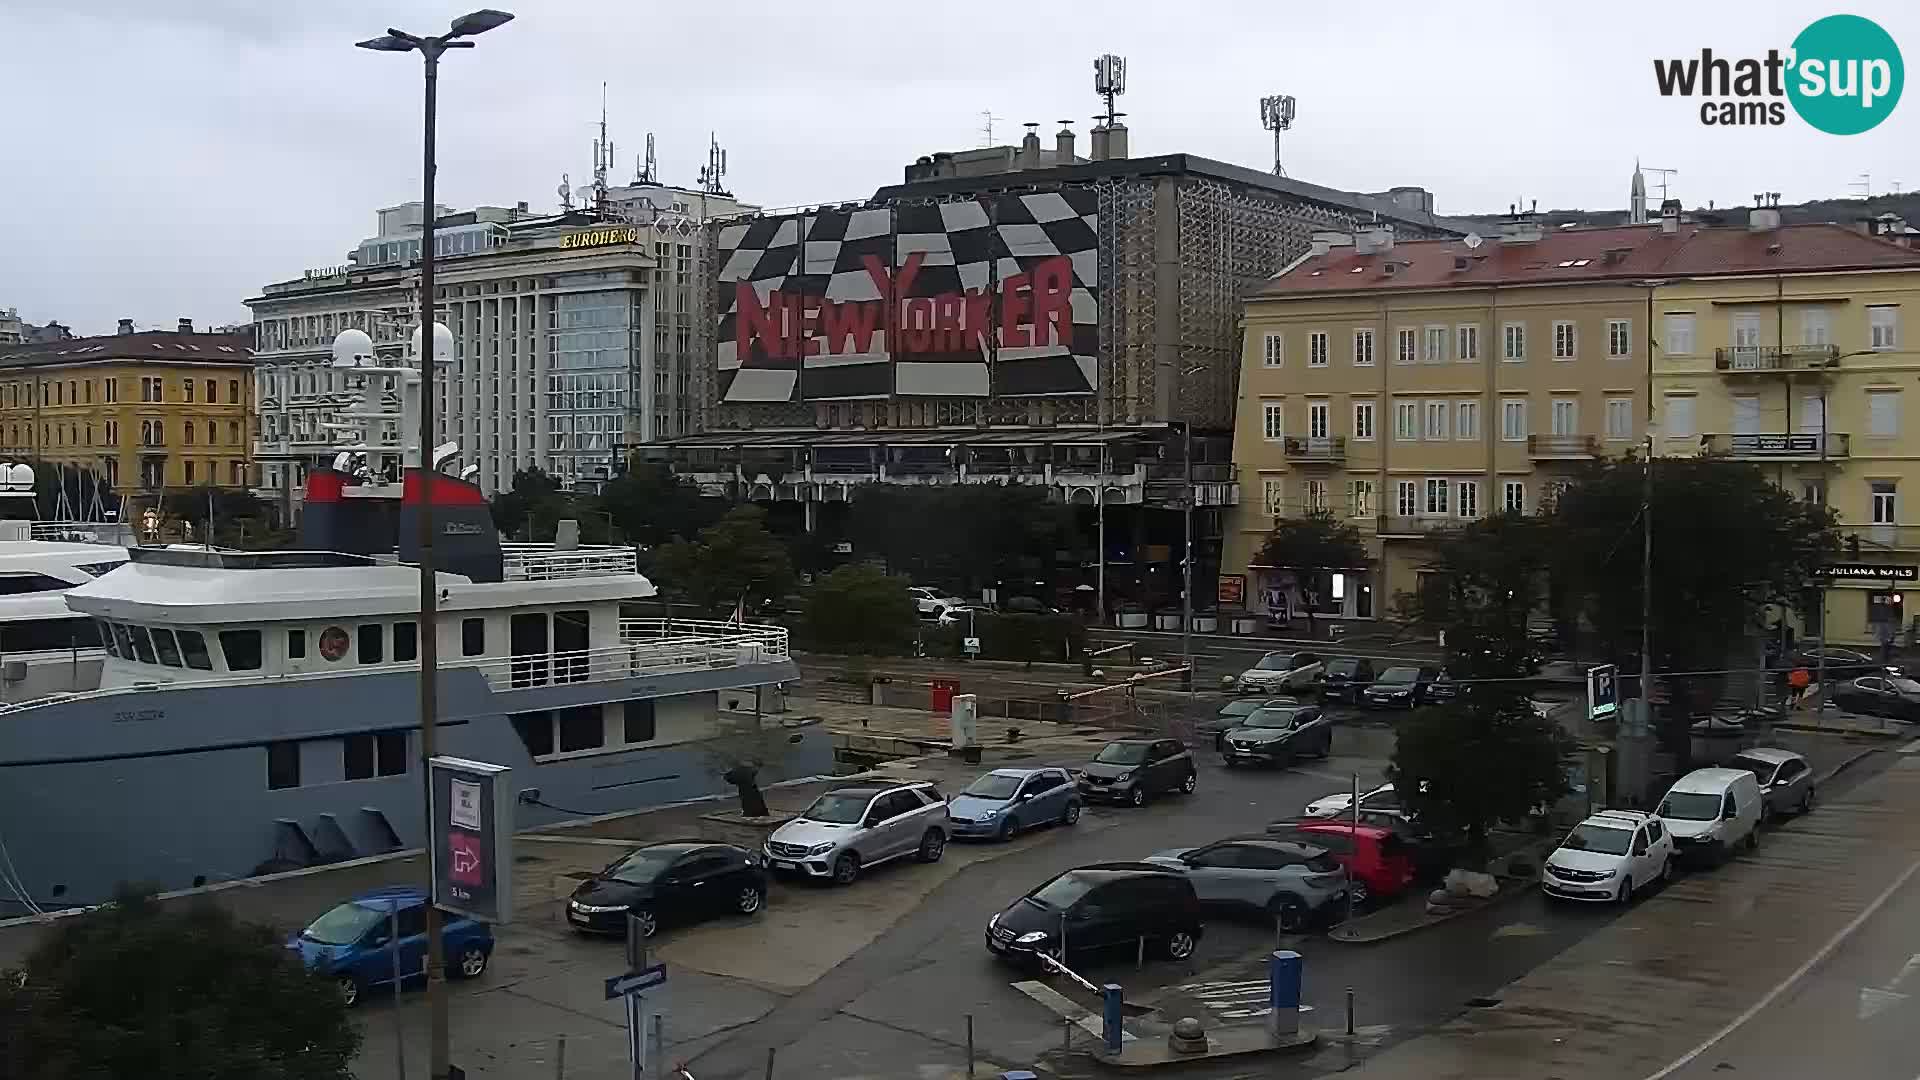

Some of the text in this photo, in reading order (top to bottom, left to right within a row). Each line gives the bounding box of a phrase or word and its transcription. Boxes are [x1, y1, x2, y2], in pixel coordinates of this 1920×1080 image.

[735, 252, 1074, 361] NEW YORKER
[1828, 567, 1913, 577] JULIANA NAILS
